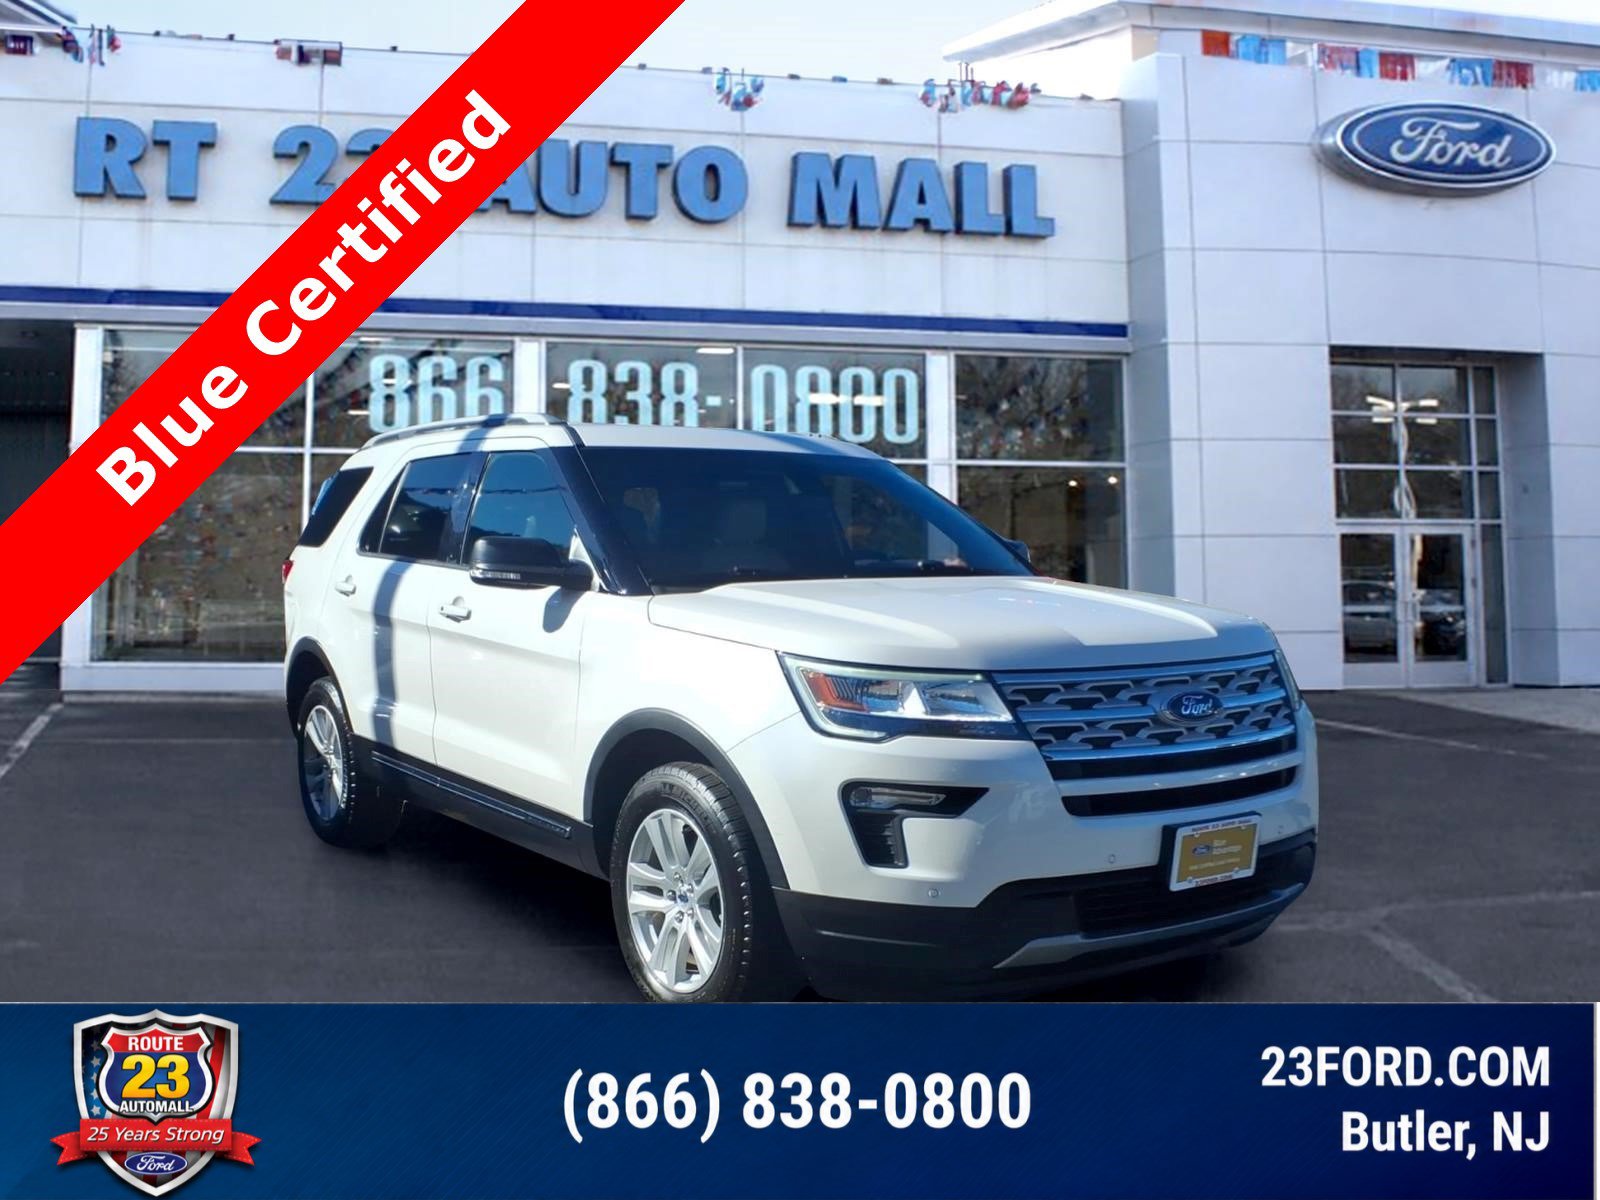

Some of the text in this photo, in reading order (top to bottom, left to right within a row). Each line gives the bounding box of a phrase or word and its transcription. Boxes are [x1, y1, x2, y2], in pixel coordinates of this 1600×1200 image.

[1390, 116, 1512, 169] Ford
[74, 116, 217, 202] RT
[270, 125, 395, 206] 2
[788, 151, 1055, 239] MALL
[369, 353, 504, 434] 866
[1181, 695, 1213, 716] Ford
